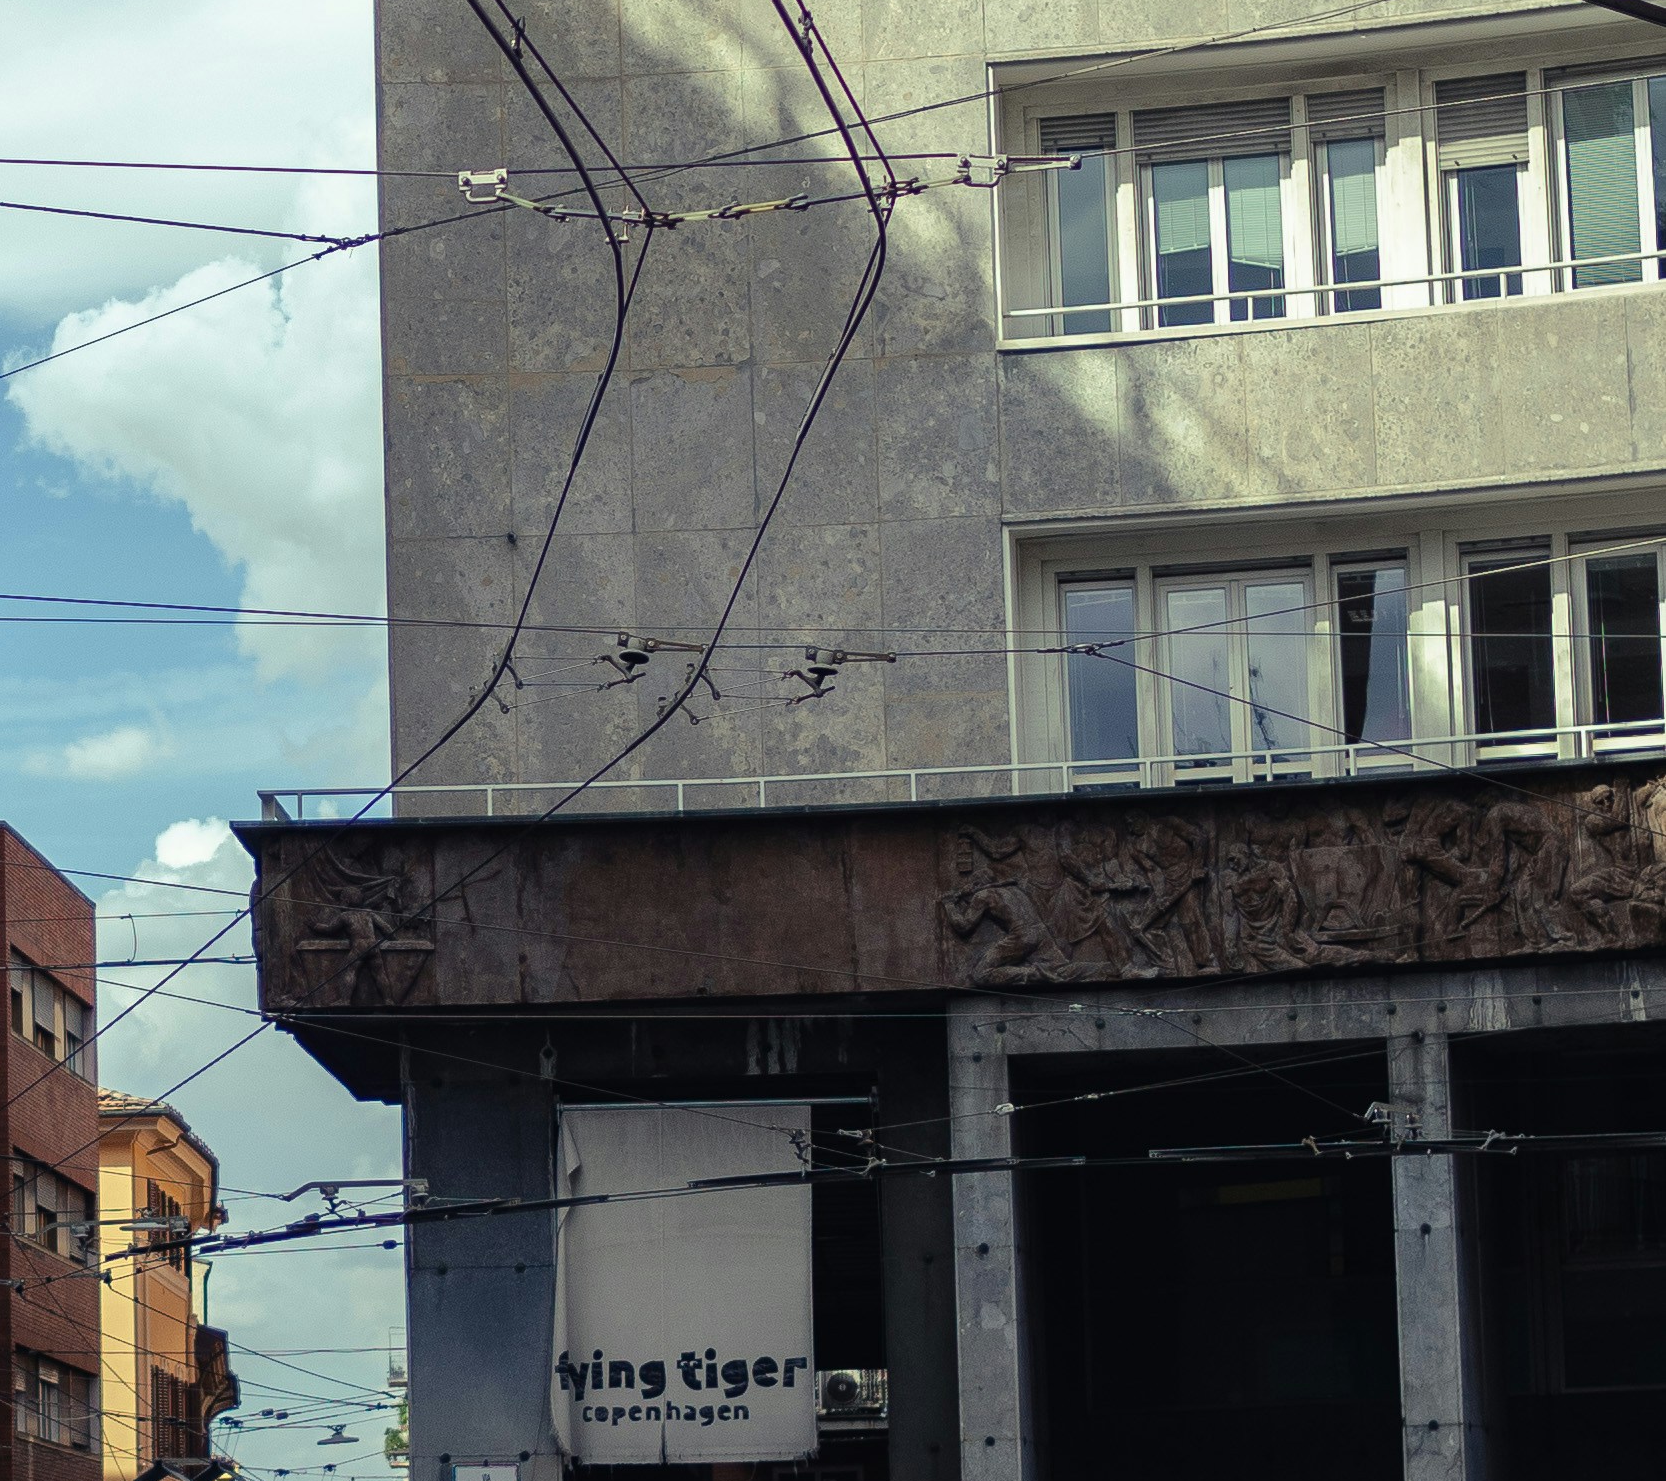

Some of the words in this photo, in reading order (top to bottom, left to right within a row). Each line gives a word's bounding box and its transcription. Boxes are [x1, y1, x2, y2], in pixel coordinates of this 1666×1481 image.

[554, 1349, 667, 1402] fying
[676, 1347, 808, 1399] tiger
[582, 1400, 750, 1427] copenhagen
